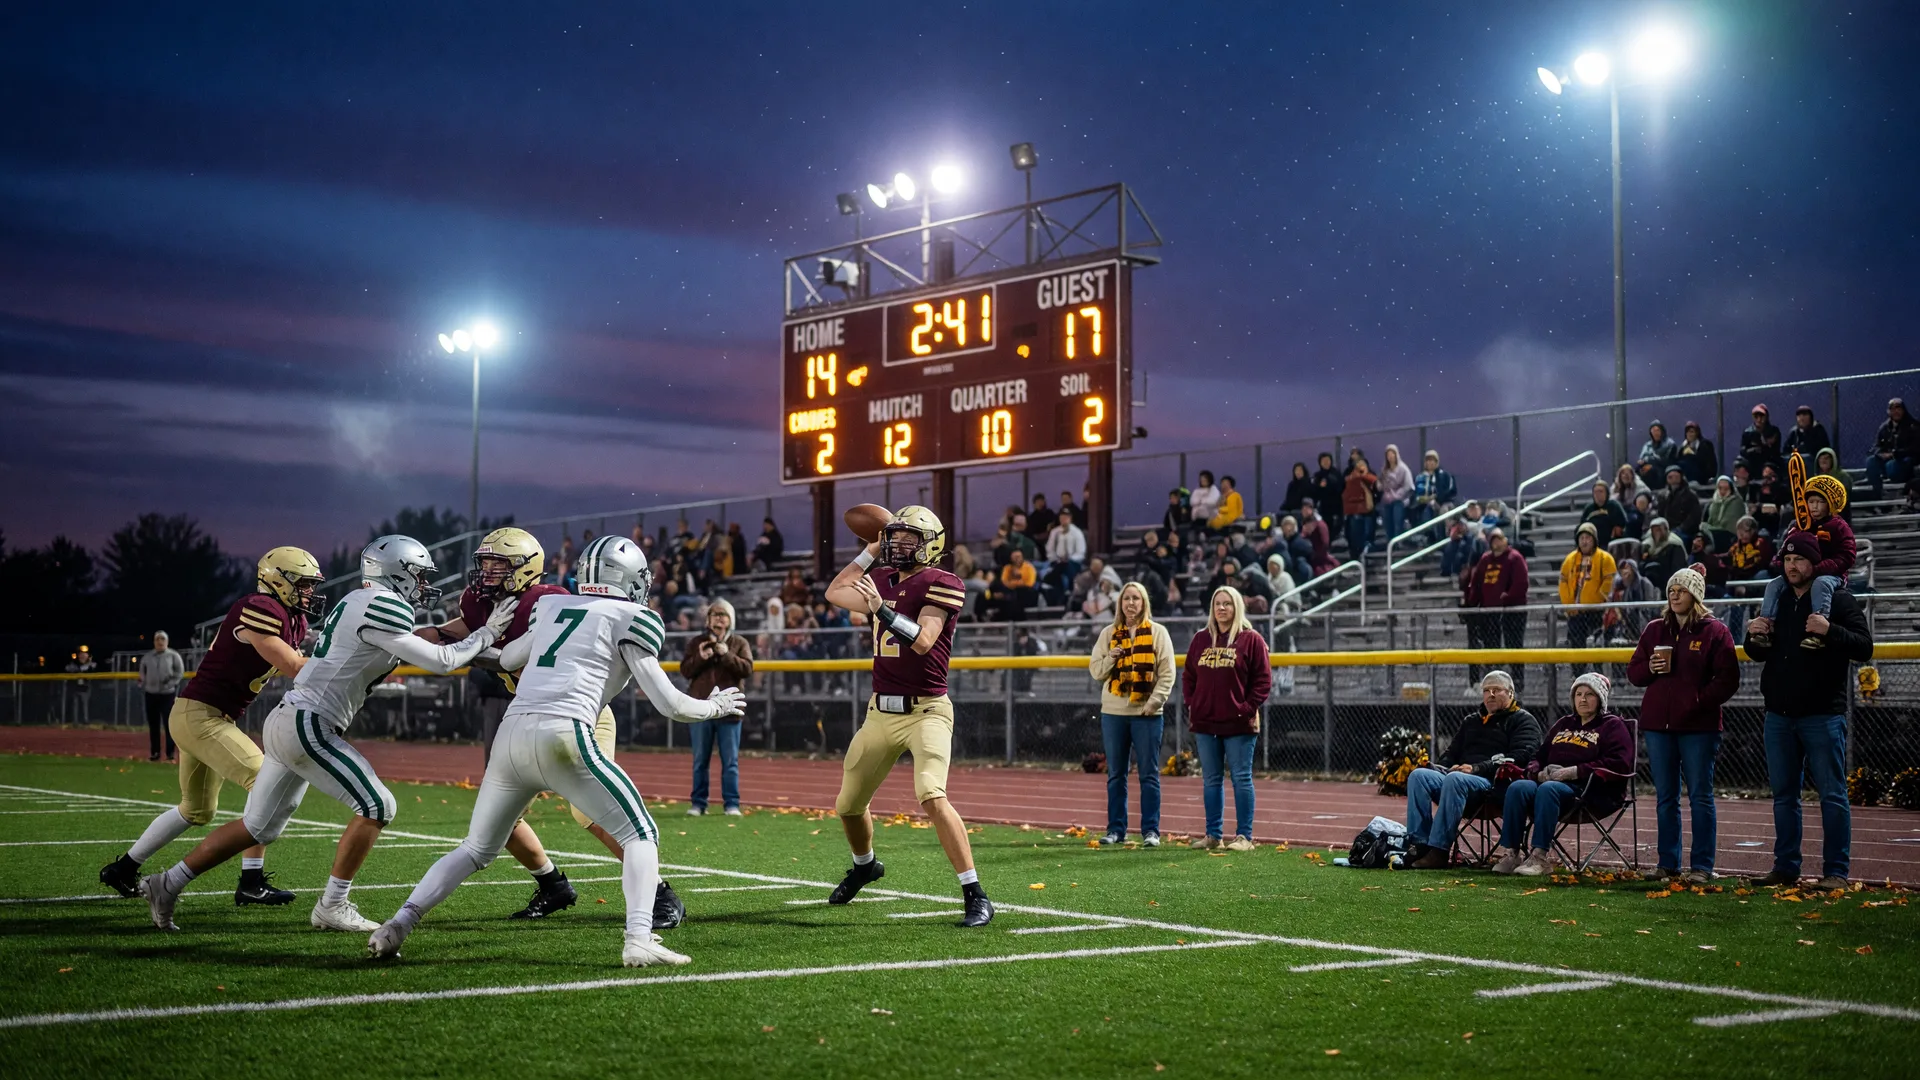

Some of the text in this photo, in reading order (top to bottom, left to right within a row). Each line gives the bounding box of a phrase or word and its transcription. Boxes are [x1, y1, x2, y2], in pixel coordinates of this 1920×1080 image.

[1037, 268, 1109, 310] GUEST
[793, 317, 845, 353] HOME
[911, 294, 991, 356] 2:41
[1066, 306, 1101, 360] 17
[806, 353, 837, 399] 14
[950, 378, 1028, 413] QUARTER
[981, 409, 1012, 455] 10
[1082, 397, 1104, 444] 2
[816, 433, 835, 474] 2
[884, 422, 912, 466] 12
[536, 608, 589, 668] 7
